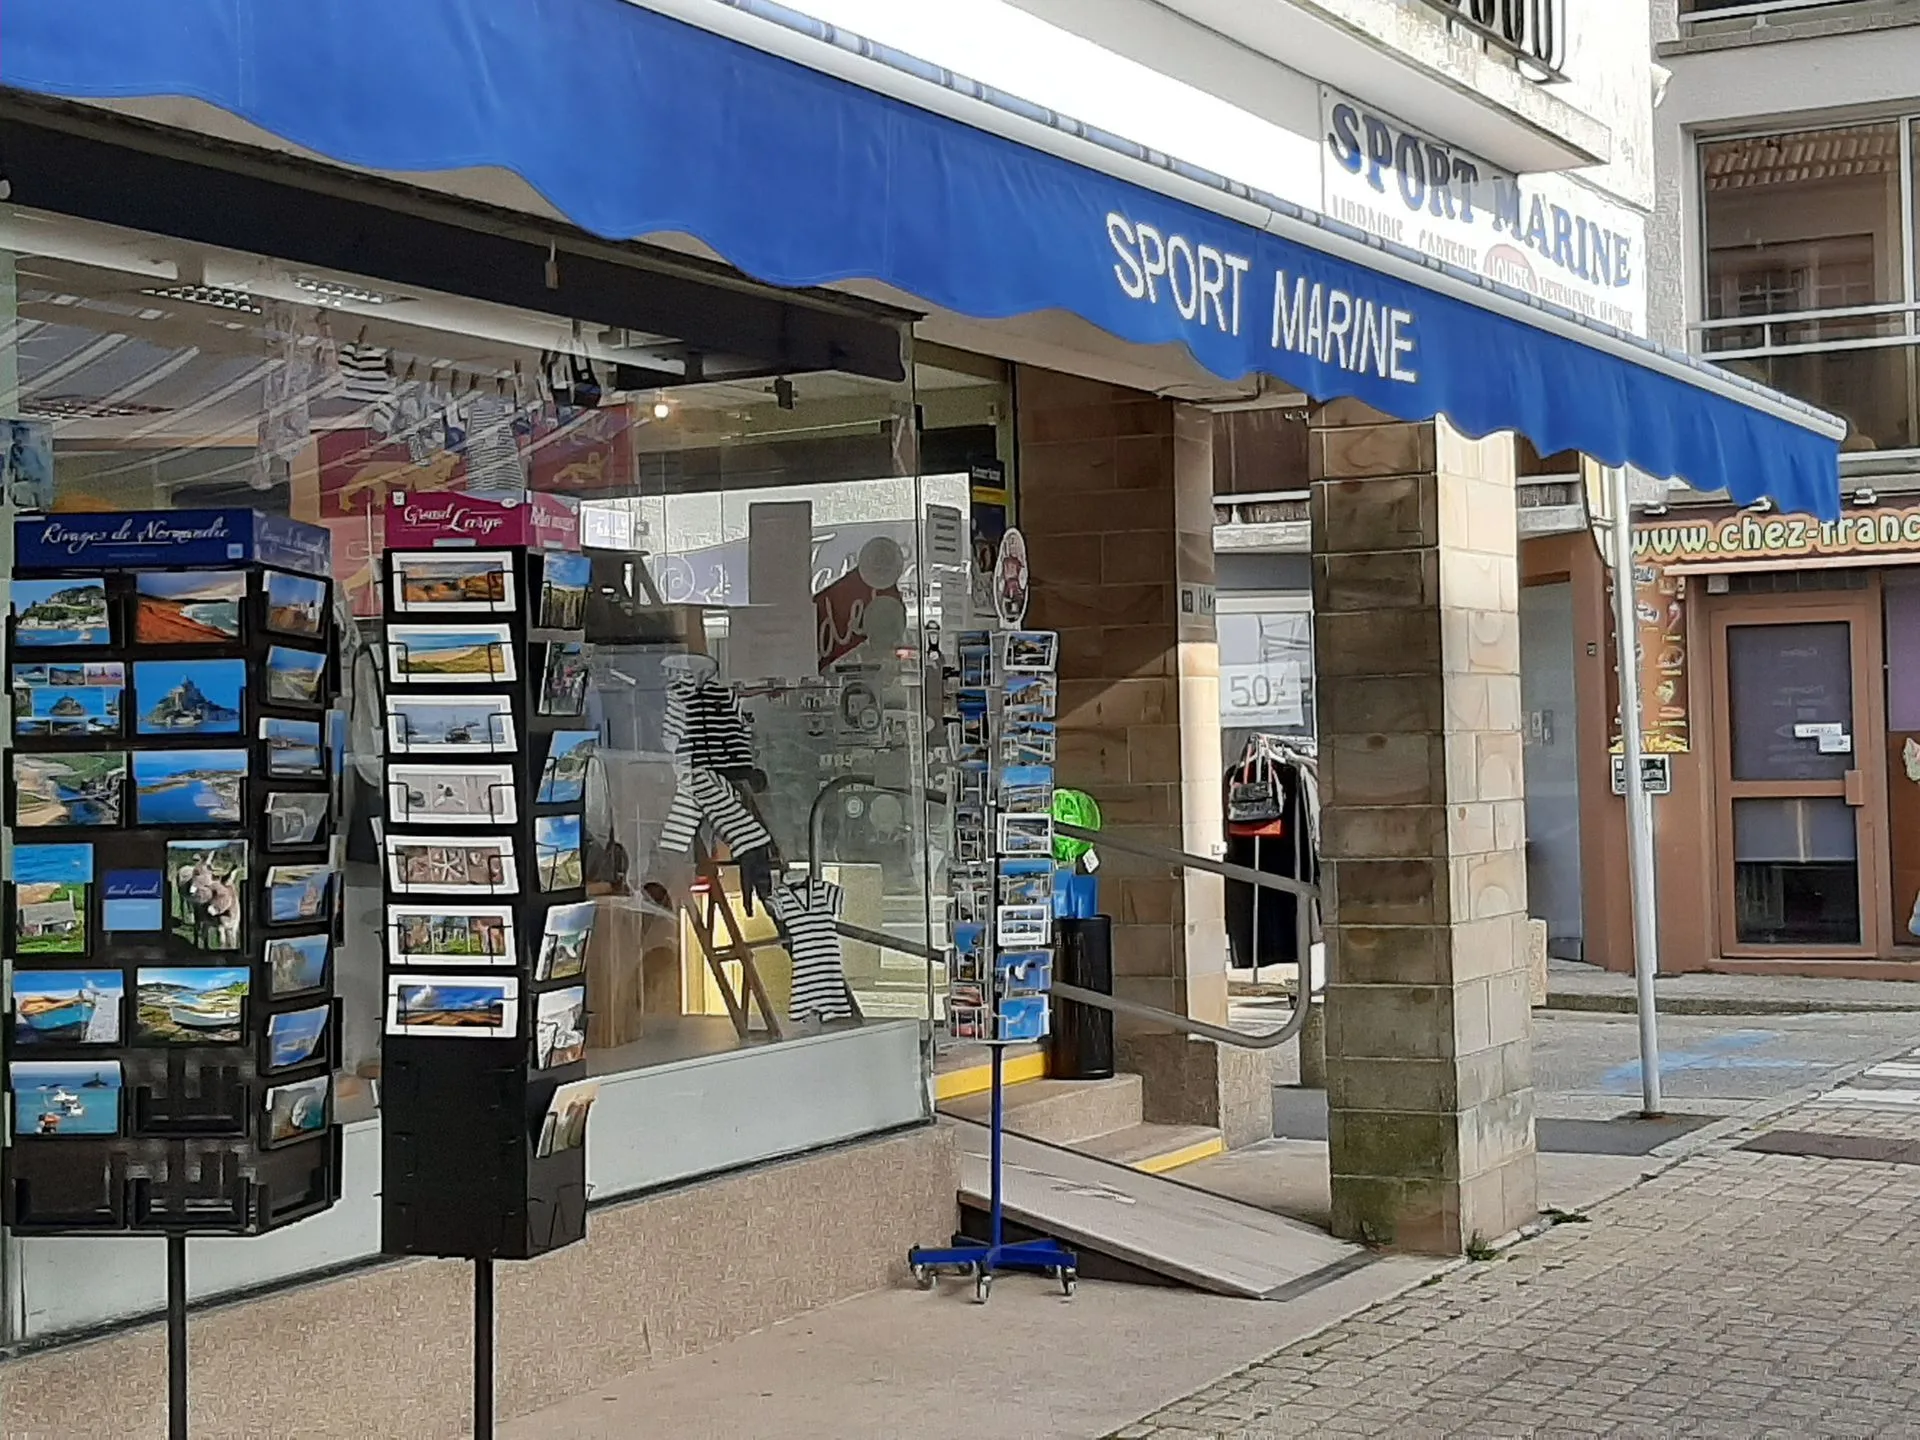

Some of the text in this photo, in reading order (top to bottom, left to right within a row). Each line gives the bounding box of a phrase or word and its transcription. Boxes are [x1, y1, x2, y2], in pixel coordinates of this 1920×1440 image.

[1327, 103, 1632, 290] SPORT MARINE
[1106, 212, 1416, 383] SPORT MARINE
[111, 518, 130, 541] de
[137, 516, 230, 543] Normandie
